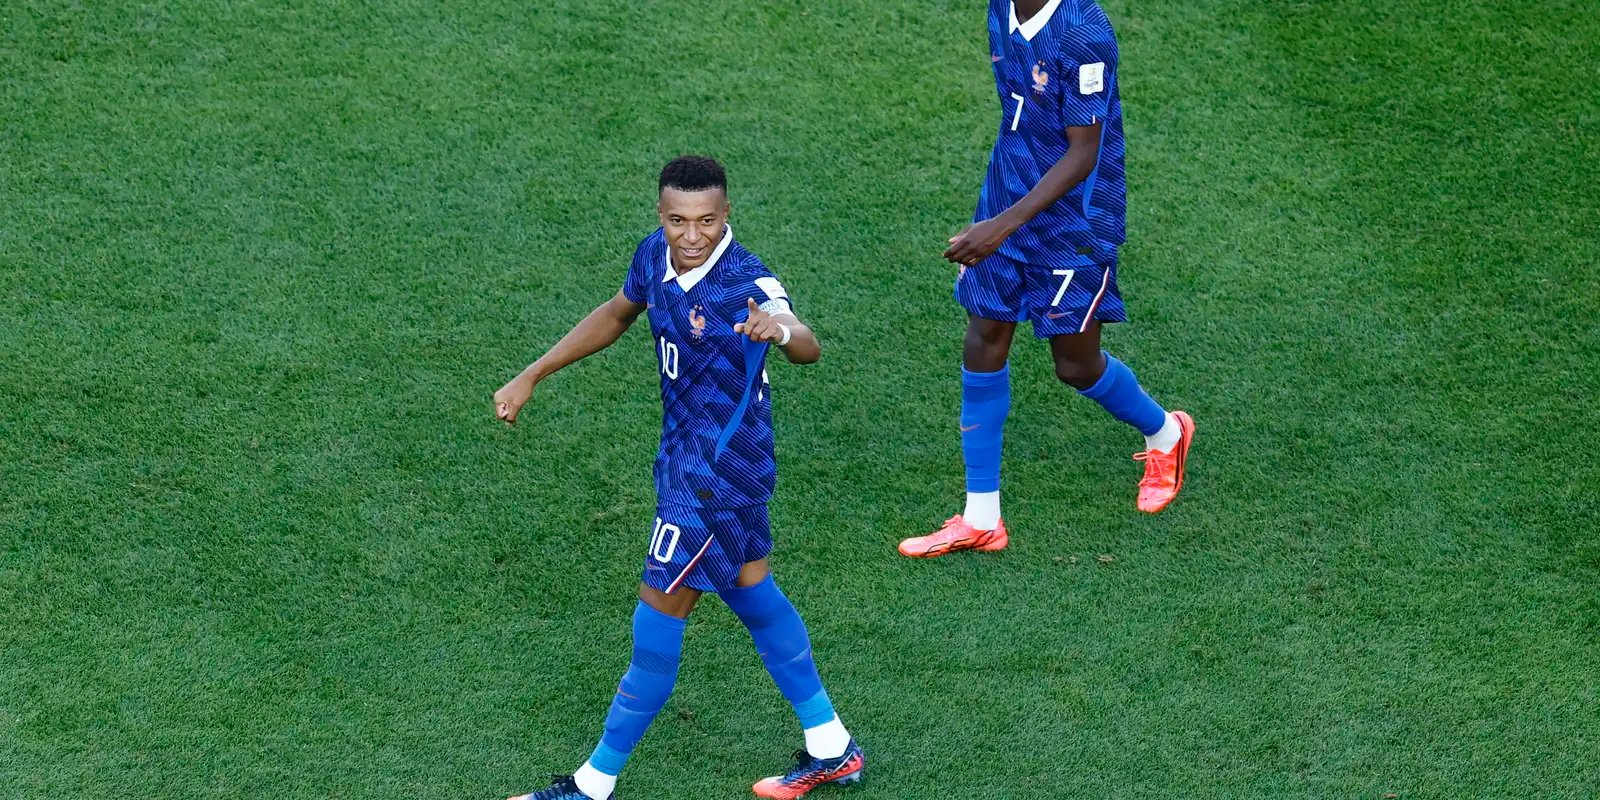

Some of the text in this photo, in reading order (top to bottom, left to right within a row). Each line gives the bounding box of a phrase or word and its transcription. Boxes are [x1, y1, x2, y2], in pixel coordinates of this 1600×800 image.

[1011, 92, 1024, 131] 7
[1051, 269, 1075, 307] 7
[660, 336, 679, 380] 10
[648, 516, 681, 563] 10
